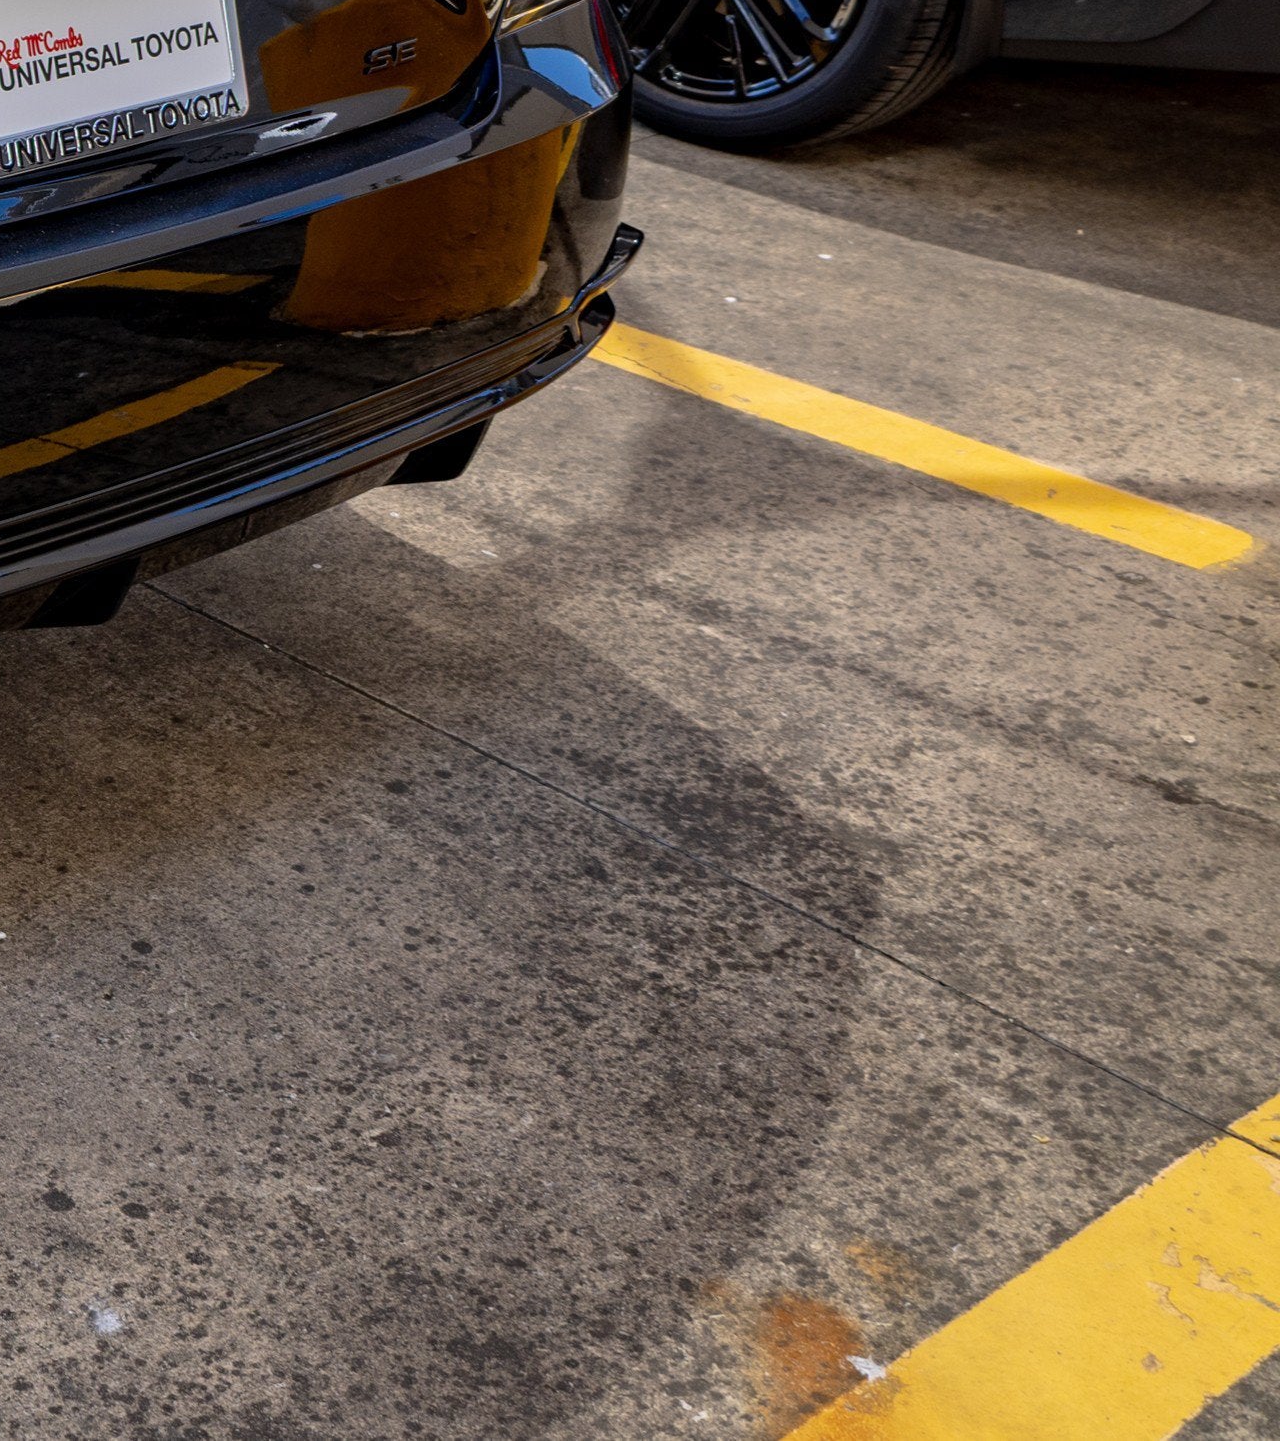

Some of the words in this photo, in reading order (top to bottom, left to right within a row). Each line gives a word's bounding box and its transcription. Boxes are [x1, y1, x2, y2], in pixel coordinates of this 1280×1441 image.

[130, 21, 219, 61] TOYOTA
[362, 38, 418, 76] SE
[142, 87, 241, 135] TOYOTA
